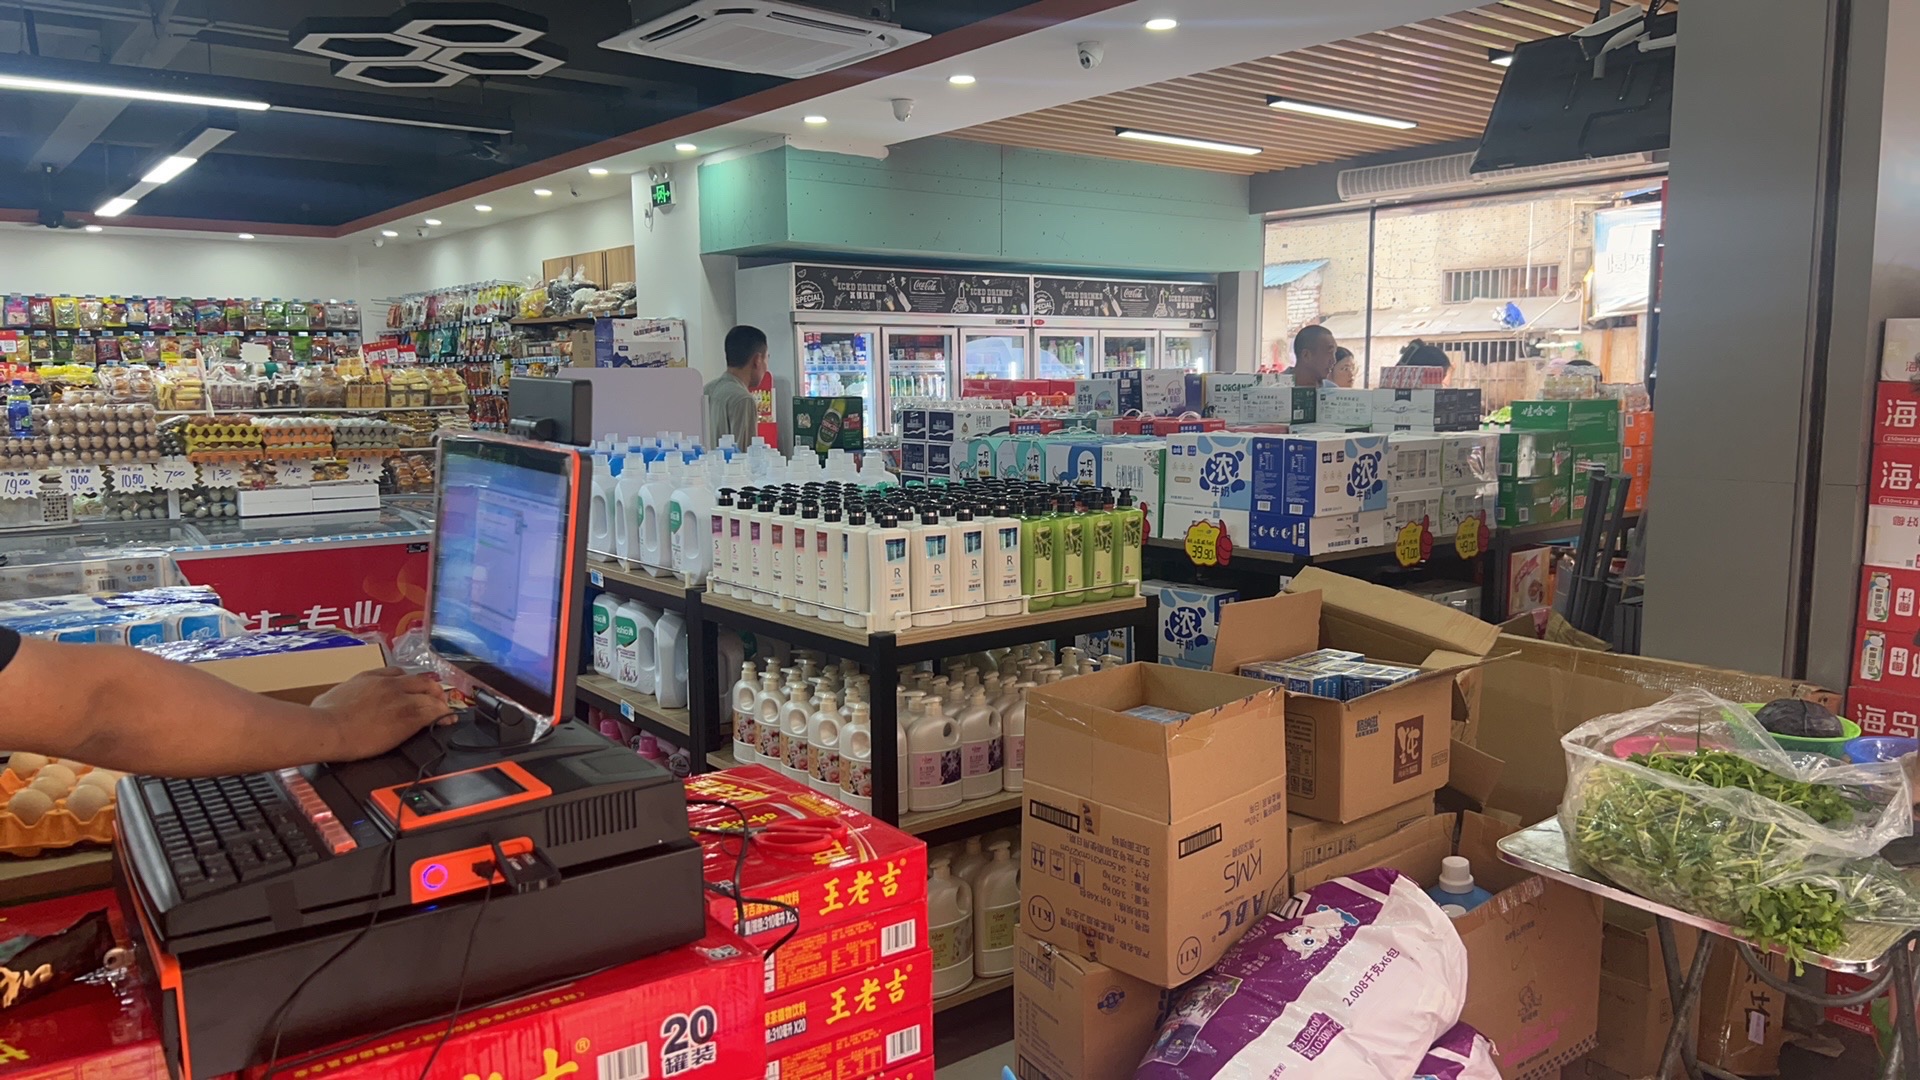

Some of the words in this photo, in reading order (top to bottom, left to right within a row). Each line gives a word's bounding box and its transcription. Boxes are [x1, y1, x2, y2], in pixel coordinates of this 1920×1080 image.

[1222, 383, 1253, 392] ORGA
[1521, 405, 1557, 417] 娃哈哈
[1884, 399, 1918, 428] 海
[978, 459, 990, 468] 水牛
[1027, 462, 1039, 472] 水牛
[1079, 458, 1093, 468] 一只
[1208, 454, 1233, 482] 浓
[1354, 455, 1374, 486] 浓
[1079, 468, 1094, 477] 水牛
[1880, 461, 1920, 490] 海
[1211, 486, 1230, 497] 牛奶
[1356, 488, 1372, 501] 牛奶
[971, 559, 978, 569] R
[1006, 556, 1013, 565] R
[894, 568, 901, 578] R
[934, 564, 941, 574] R
[1174, 609, 1196, 636] 浓
[1111, 629, 1124, 640] 水牛
[1176, 638, 1194, 651] 牛奶
[1857, 703, 1918, 740] 海岛
[1223, 848, 1262, 894] KMS
[819, 861, 902, 916] 王老吉
[1032, 905, 1052, 923] K11
[1114, 913, 1127, 924] K11
[1217, 889, 1266, 937] ABC
[1179, 946, 1199, 966] K11
[1342, 947, 1400, 1007] 2.008千克x6包
[826, 968, 908, 1025] 王老吉
[664, 1008, 717, 1054] 20
[666, 1043, 717, 1076] 罐装
